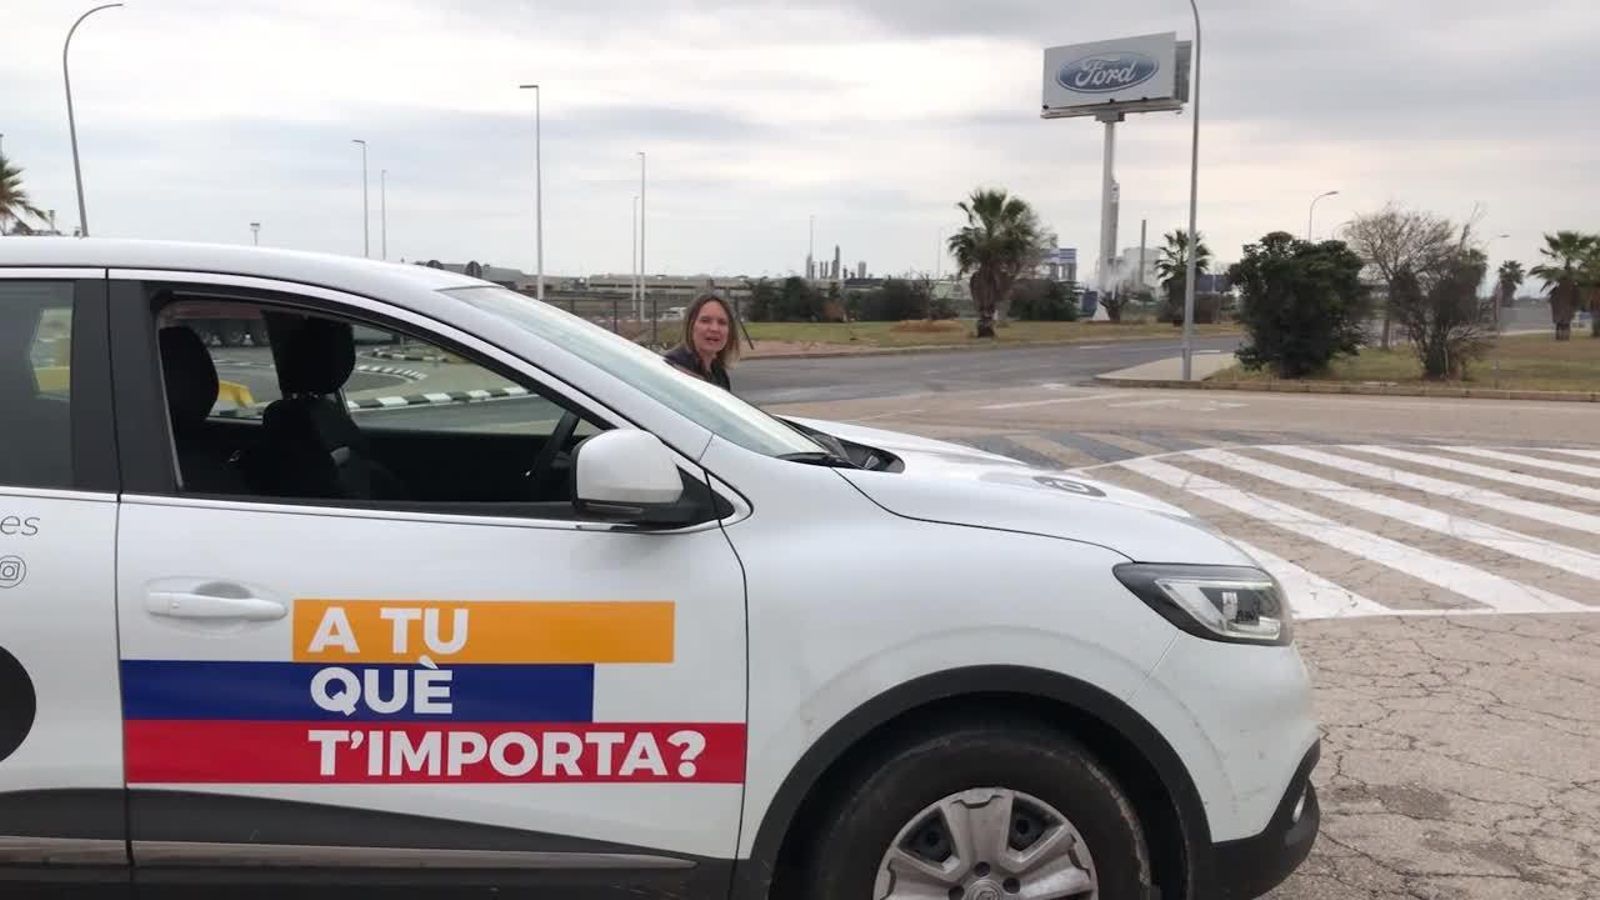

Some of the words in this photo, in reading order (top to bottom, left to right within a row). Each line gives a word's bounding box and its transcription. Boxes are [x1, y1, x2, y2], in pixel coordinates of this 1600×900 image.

[1075, 57, 1137, 87] Ford
[308, 607, 360, 653] A
[380, 608, 469, 655] TU
[310, 655, 453, 716] QUÈ
[308, 730, 706, 778] T'IMPORTA?
